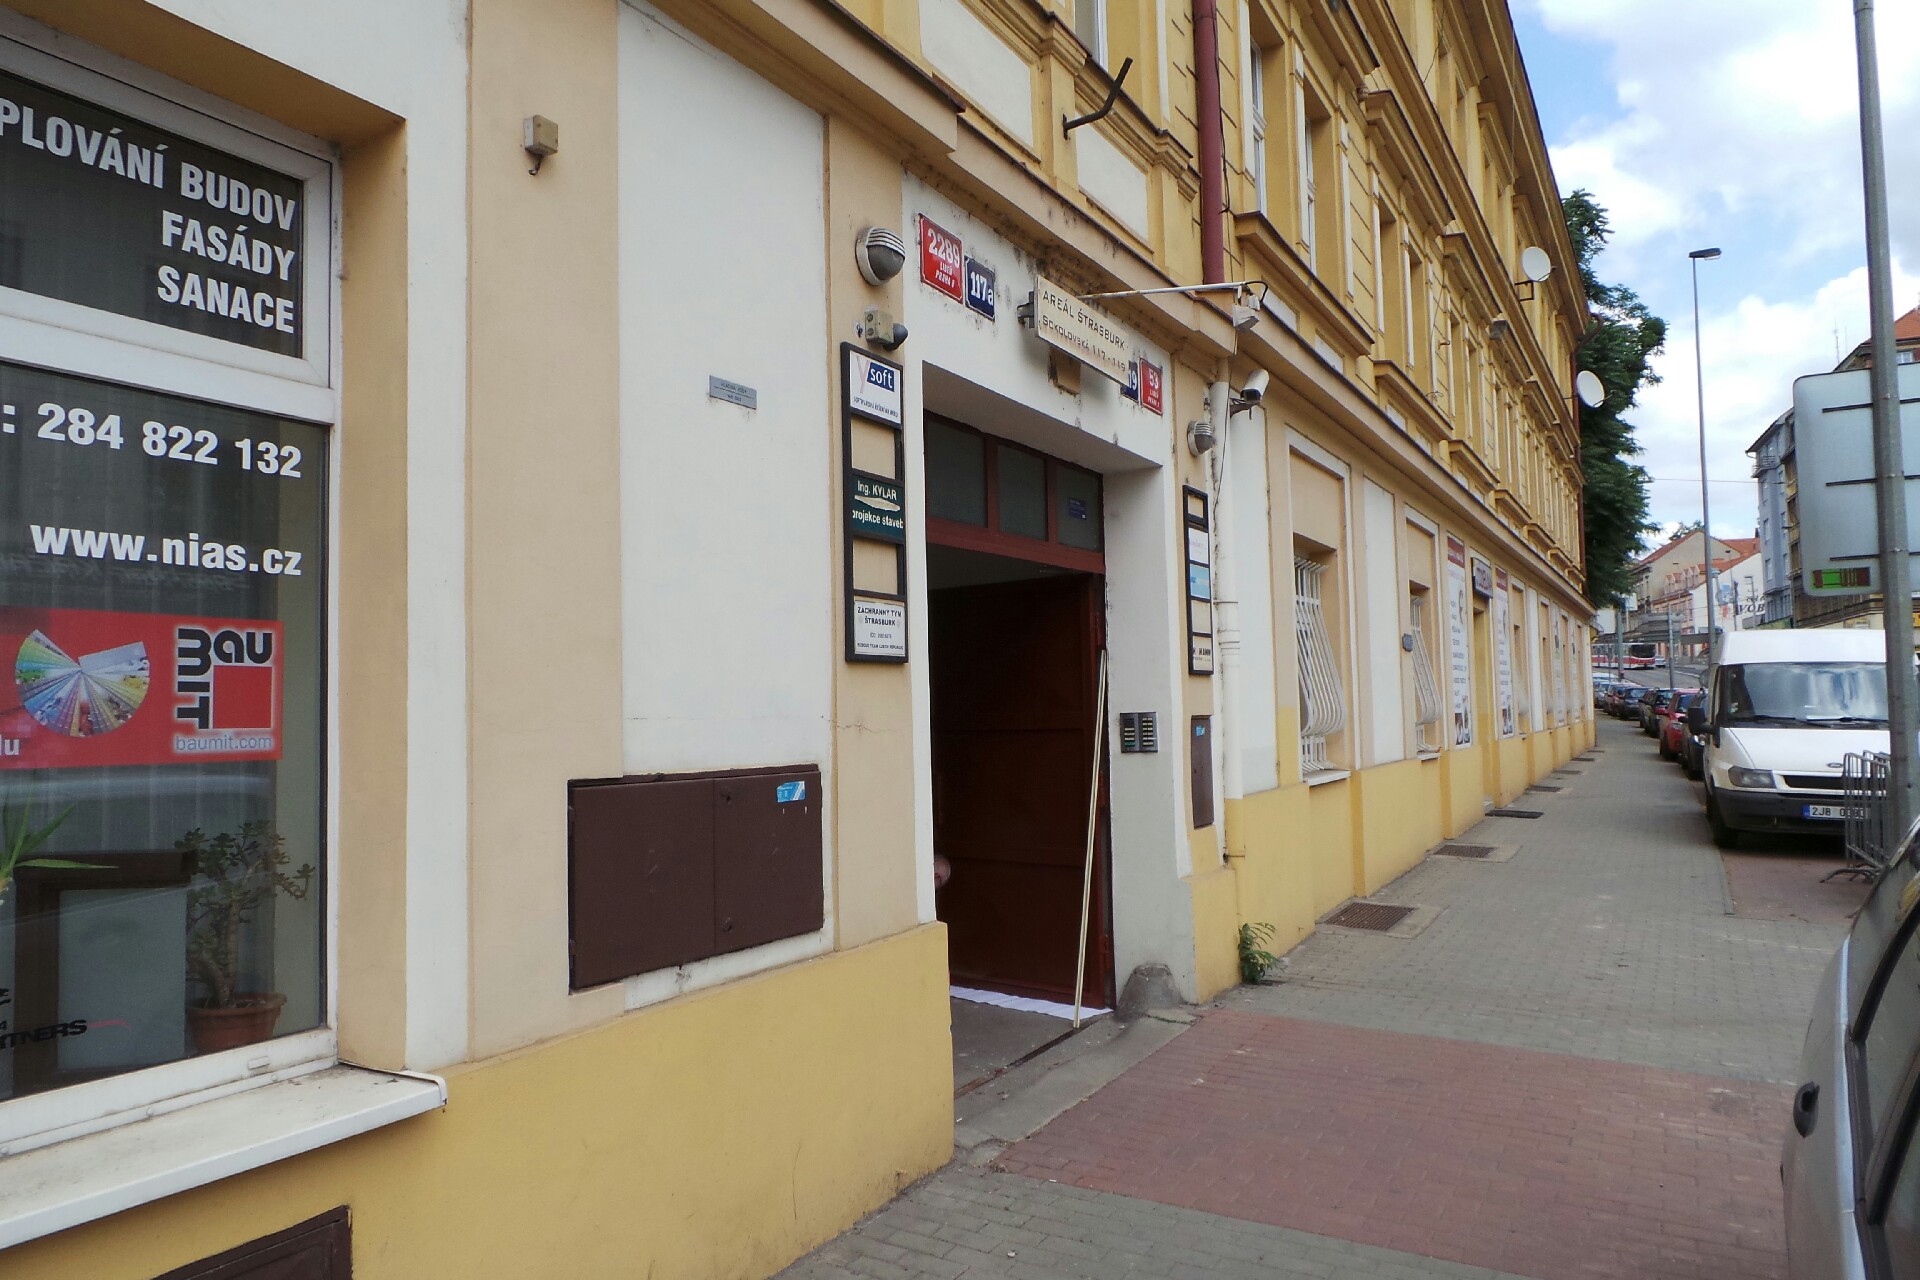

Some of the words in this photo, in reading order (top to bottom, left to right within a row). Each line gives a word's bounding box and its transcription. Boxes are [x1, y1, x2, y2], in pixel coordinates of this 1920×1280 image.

[181, 161, 296, 231] BUDOV
[162, 209, 295, 281] FASÁDY
[927, 228, 960, 269] 2289
[157, 265, 294, 334] SANACE
[970, 271, 994, 306] 117a
[1042, 290, 1074, 319] AREÁL
[870, 368, 893, 389] soft
[37, 402, 124, 450] 284
[142, 420, 219, 465] 822
[234, 438, 302, 478] 132
[857, 480, 871, 496] Ing.
[872, 485, 897, 501] KYLAR
[30, 524, 302, 576] www.nias.cz
[175, 734, 273, 751] baumit.com
[1812, 807, 1831, 816] 2J8
